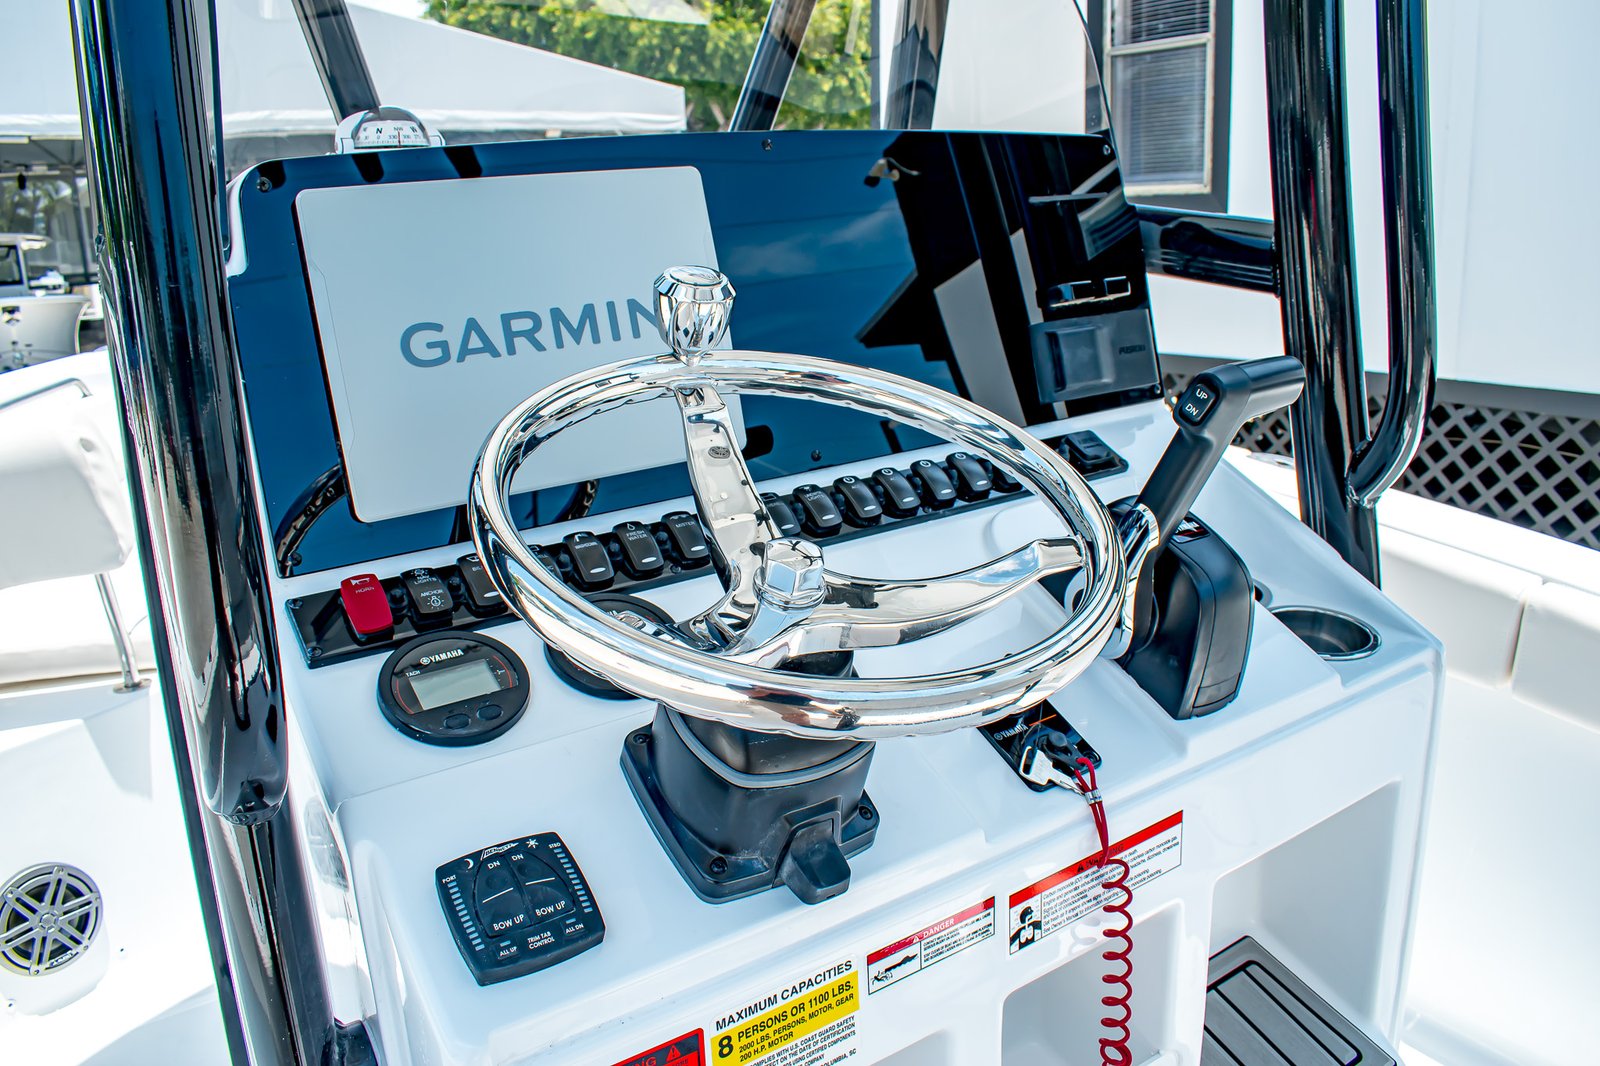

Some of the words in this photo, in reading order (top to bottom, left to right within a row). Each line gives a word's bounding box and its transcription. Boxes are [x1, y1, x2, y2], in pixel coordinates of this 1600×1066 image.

[1196, 388, 1208, 400] UP
[1185, 403, 1199, 416] DN
[414, 577, 437, 585] LIGHTS
[355, 586, 375, 594] HORN
[420, 589, 444, 597] ANCHOR
[429, 649, 464, 663] YAMAHA
[1000, 723, 1029, 738] YAMAHA
[511, 853, 524, 862] DN
[487, 860, 500, 870] DN
[442, 874, 457, 884] PORT
[535, 904, 554, 917] BOW
[555, 900, 566, 911] UP
[493, 919, 513, 931] BOW
[514, 914, 525, 924] UP
[565, 926, 575, 934] ALL
[574, 922, 584, 930] DN
[923, 918, 954, 938] DANGER
[527, 934, 540, 943] TRIM
[540, 931, 552, 940] TAB
[528, 937, 555, 950] CONTROL
[500, 949, 510, 957] ALL
[510, 946, 518, 954] UP
[716, 994, 778, 1032] MAXIMUM
[780, 960, 852, 1000] CAPACITIES
[738, 1010, 788, 1042] PERSONS
[790, 1002, 806, 1017] OR
[808, 991, 830, 1009] 1100
[832, 980, 854, 997] LBS.
[738, 1040, 755, 1054] 2000
[756, 1034, 772, 1046] LBS.
[773, 1016, 808, 1038] PERSONS,
[808, 1004, 834, 1020] MOTOR,
[835, 993, 854, 1007] GEAR
[776, 1046, 790, 1058] WITH
[790, 1042, 800, 1052] U.S.
[800, 1033, 818, 1046] COAST
[818, 1024, 836, 1038] GUARD
[836, 1015, 855, 1030] SAFETY
[788, 1050, 798, 1060] THE
[799, 1044, 812, 1056] DATE
[820, 1022, 856, 1044] CERTIFICATION
[828, 1030, 856, 1048] COMPONENTS
[718, 1035, 734, 1059] 8
[739, 1051, 752, 1062] 200
[754, 1045, 767, 1056] H.P.
[768, 1031, 794, 1049] MOTOR
[848, 1048, 857, 1056] SC
[804, 1054, 825, 1066] COMPANY
